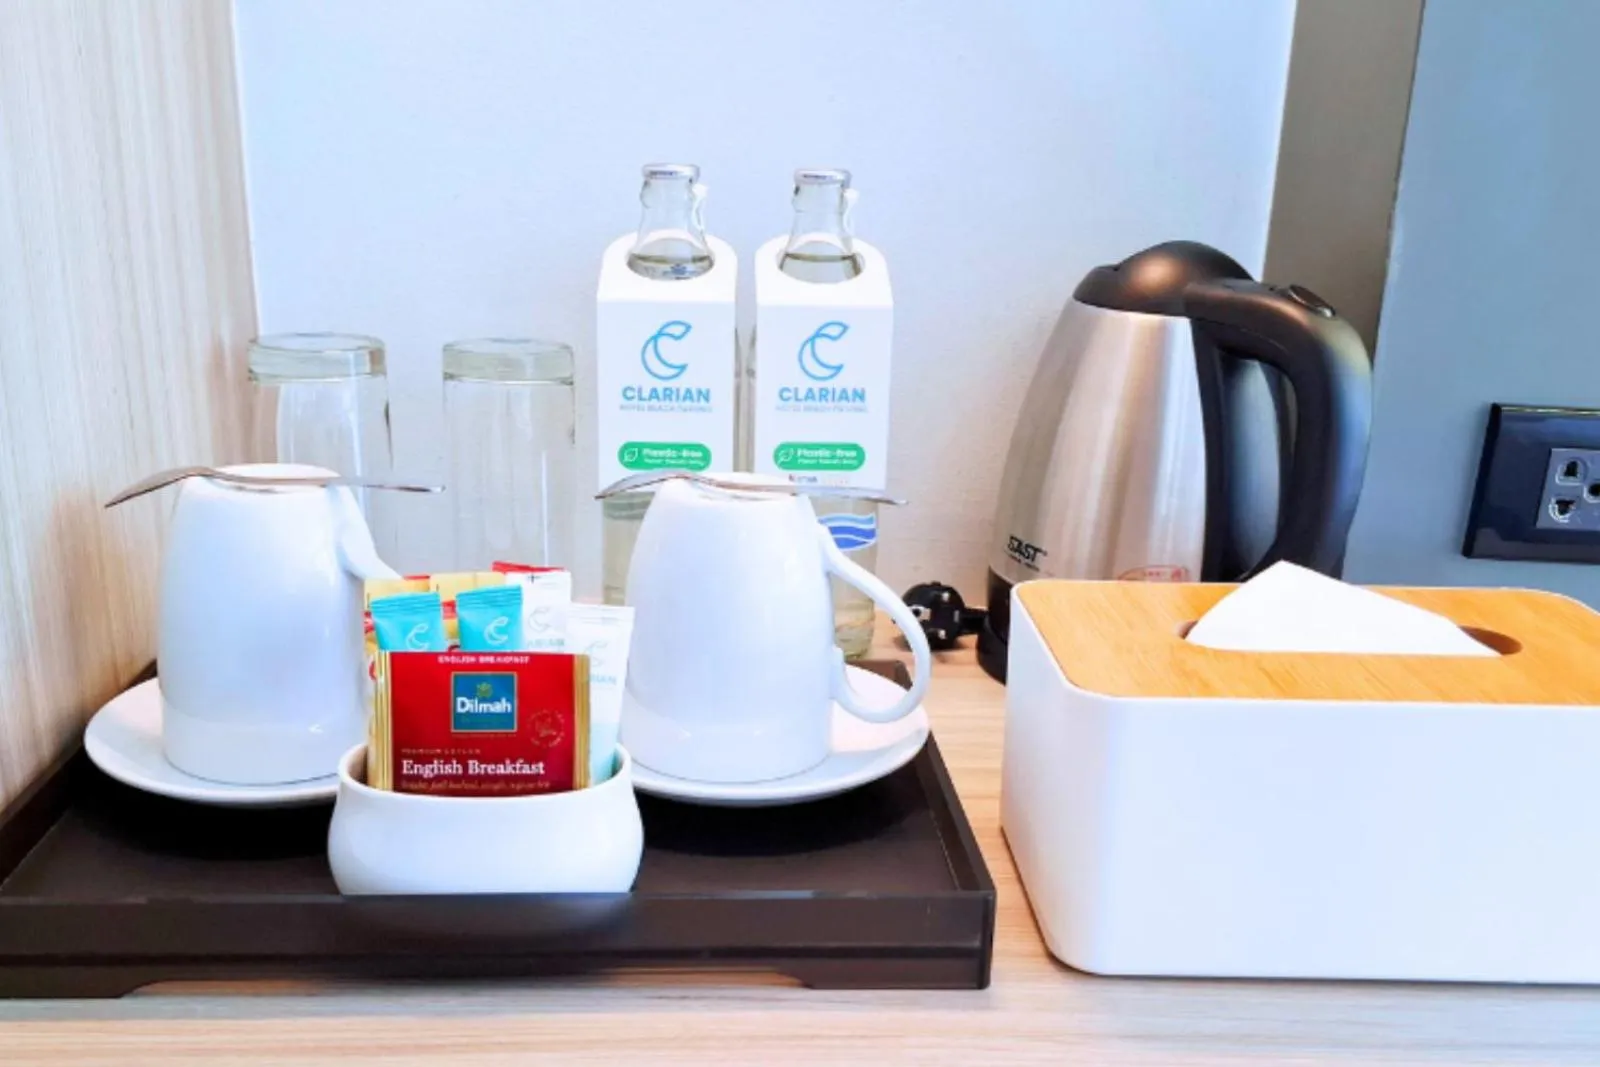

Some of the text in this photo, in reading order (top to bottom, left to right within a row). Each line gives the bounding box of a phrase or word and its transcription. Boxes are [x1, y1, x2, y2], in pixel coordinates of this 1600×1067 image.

[621, 385, 711, 403] CLARIAN
[778, 386, 866, 403] CLARIAN
[437, 655, 530, 664] ENGLISH BREAKFAST
[456, 697, 512, 713] Dilmah
[402, 759, 545, 778] English Breakfast
